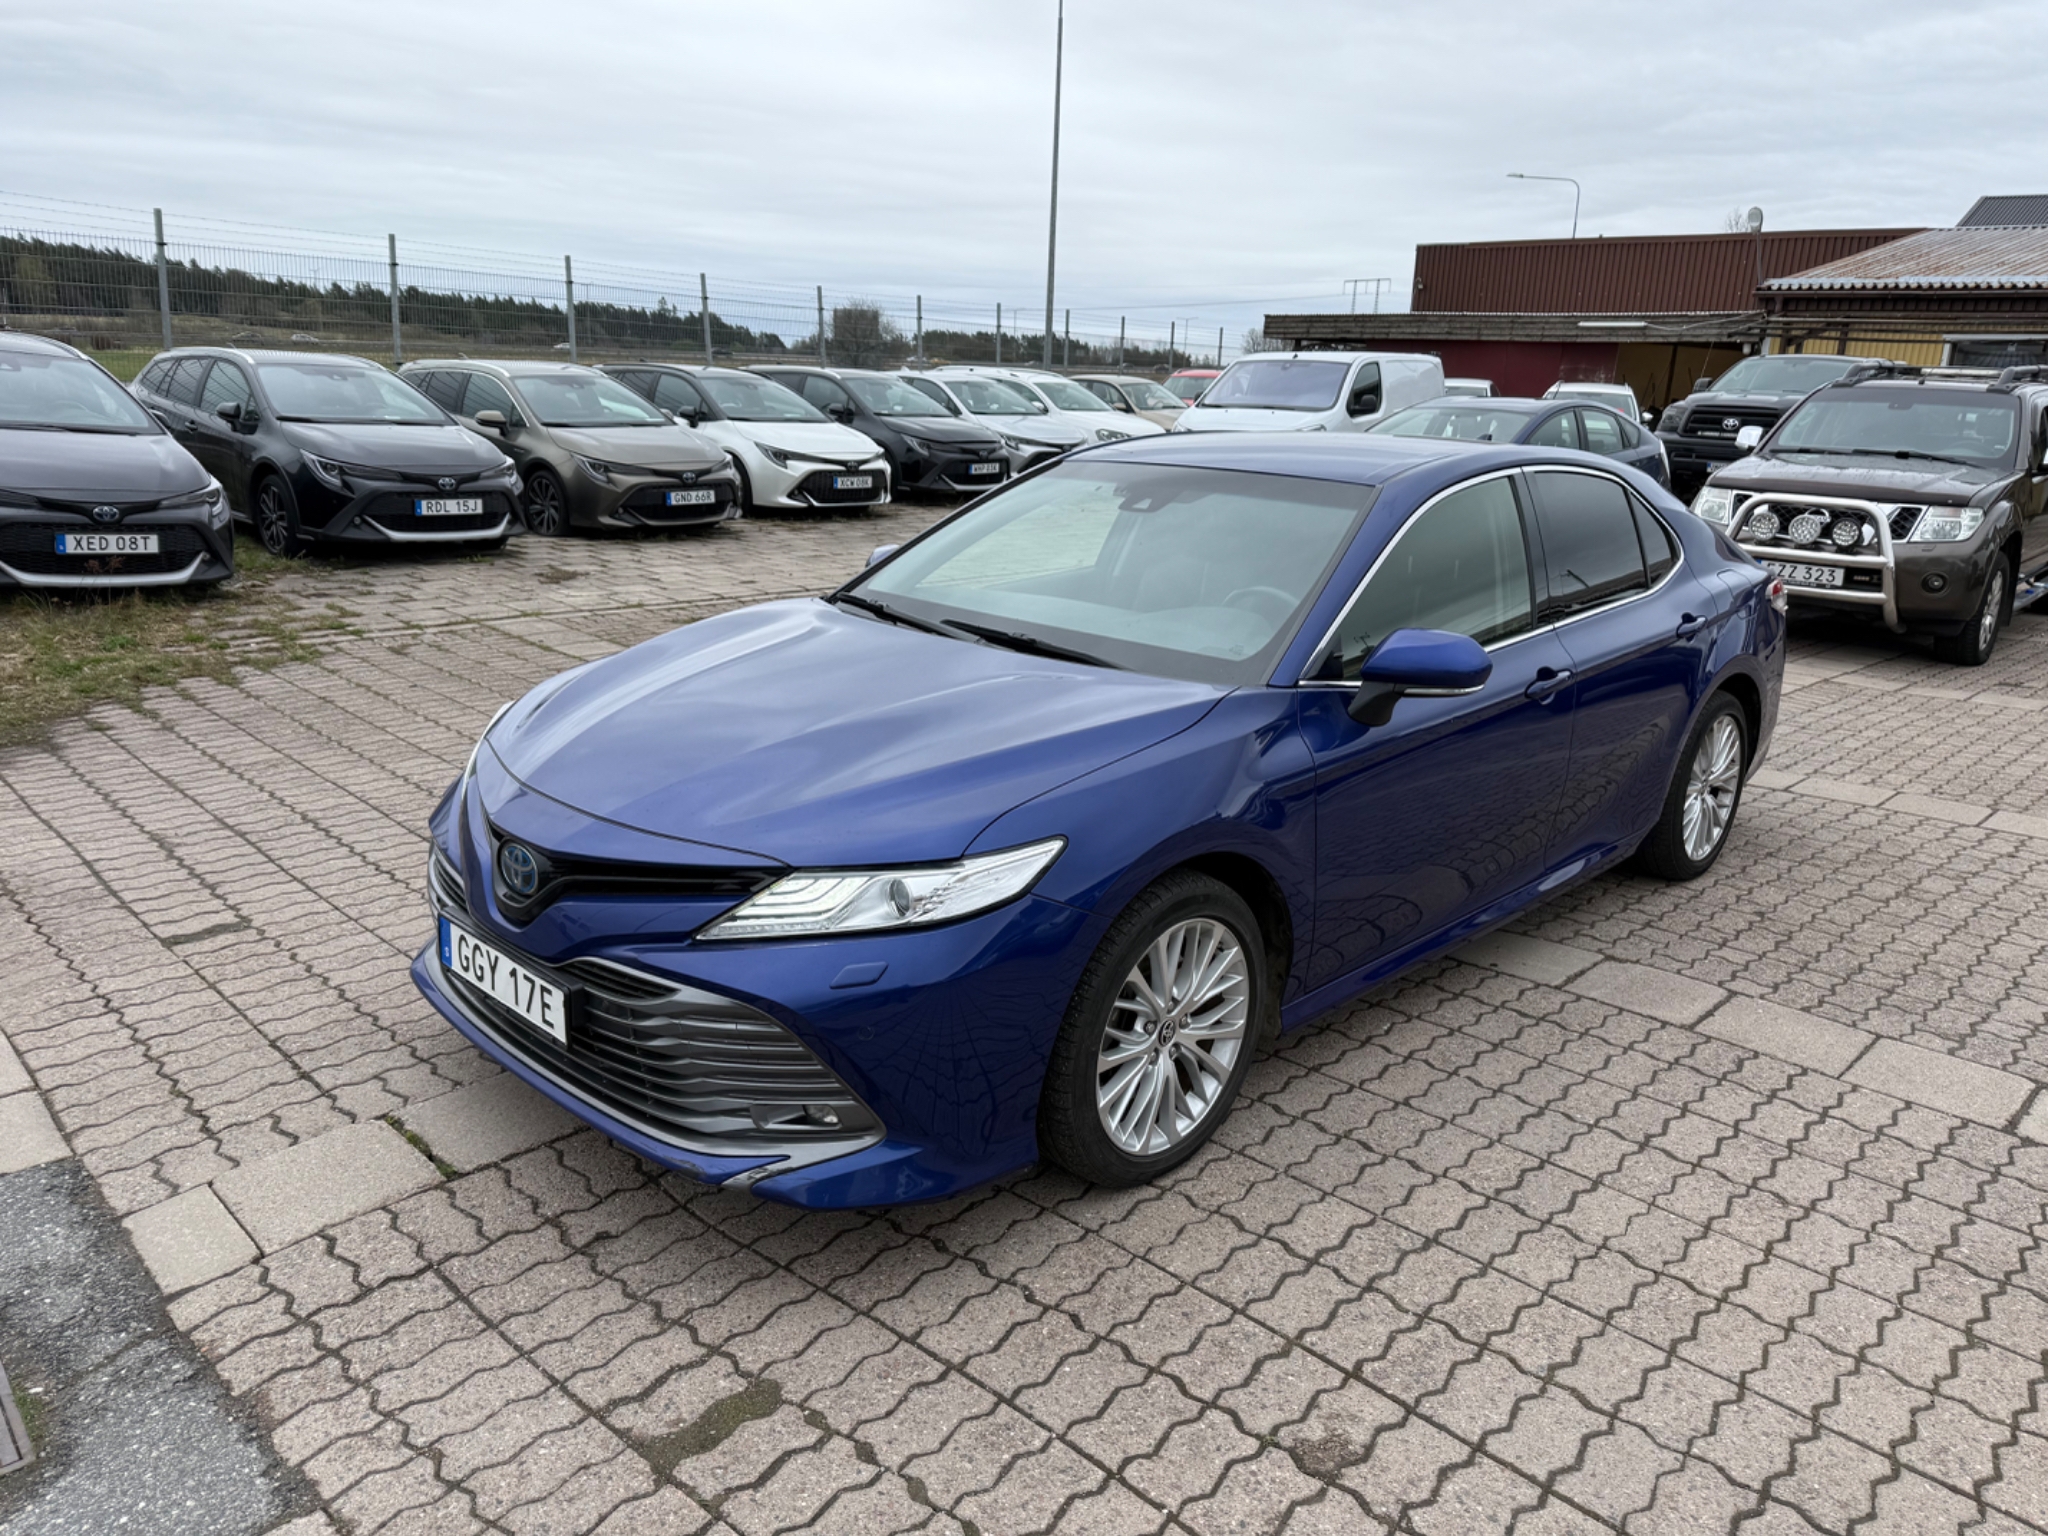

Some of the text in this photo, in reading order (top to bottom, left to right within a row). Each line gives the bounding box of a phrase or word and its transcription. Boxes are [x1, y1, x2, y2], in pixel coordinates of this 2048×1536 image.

[674, 491, 711, 503] GND 66R
[426, 500, 477, 513] RDL 15J
[73, 536, 150, 551] XED 08T
[1803, 567, 1836, 583] 323
[458, 933, 499, 991] GGY
[509, 967, 554, 1029] 17E
